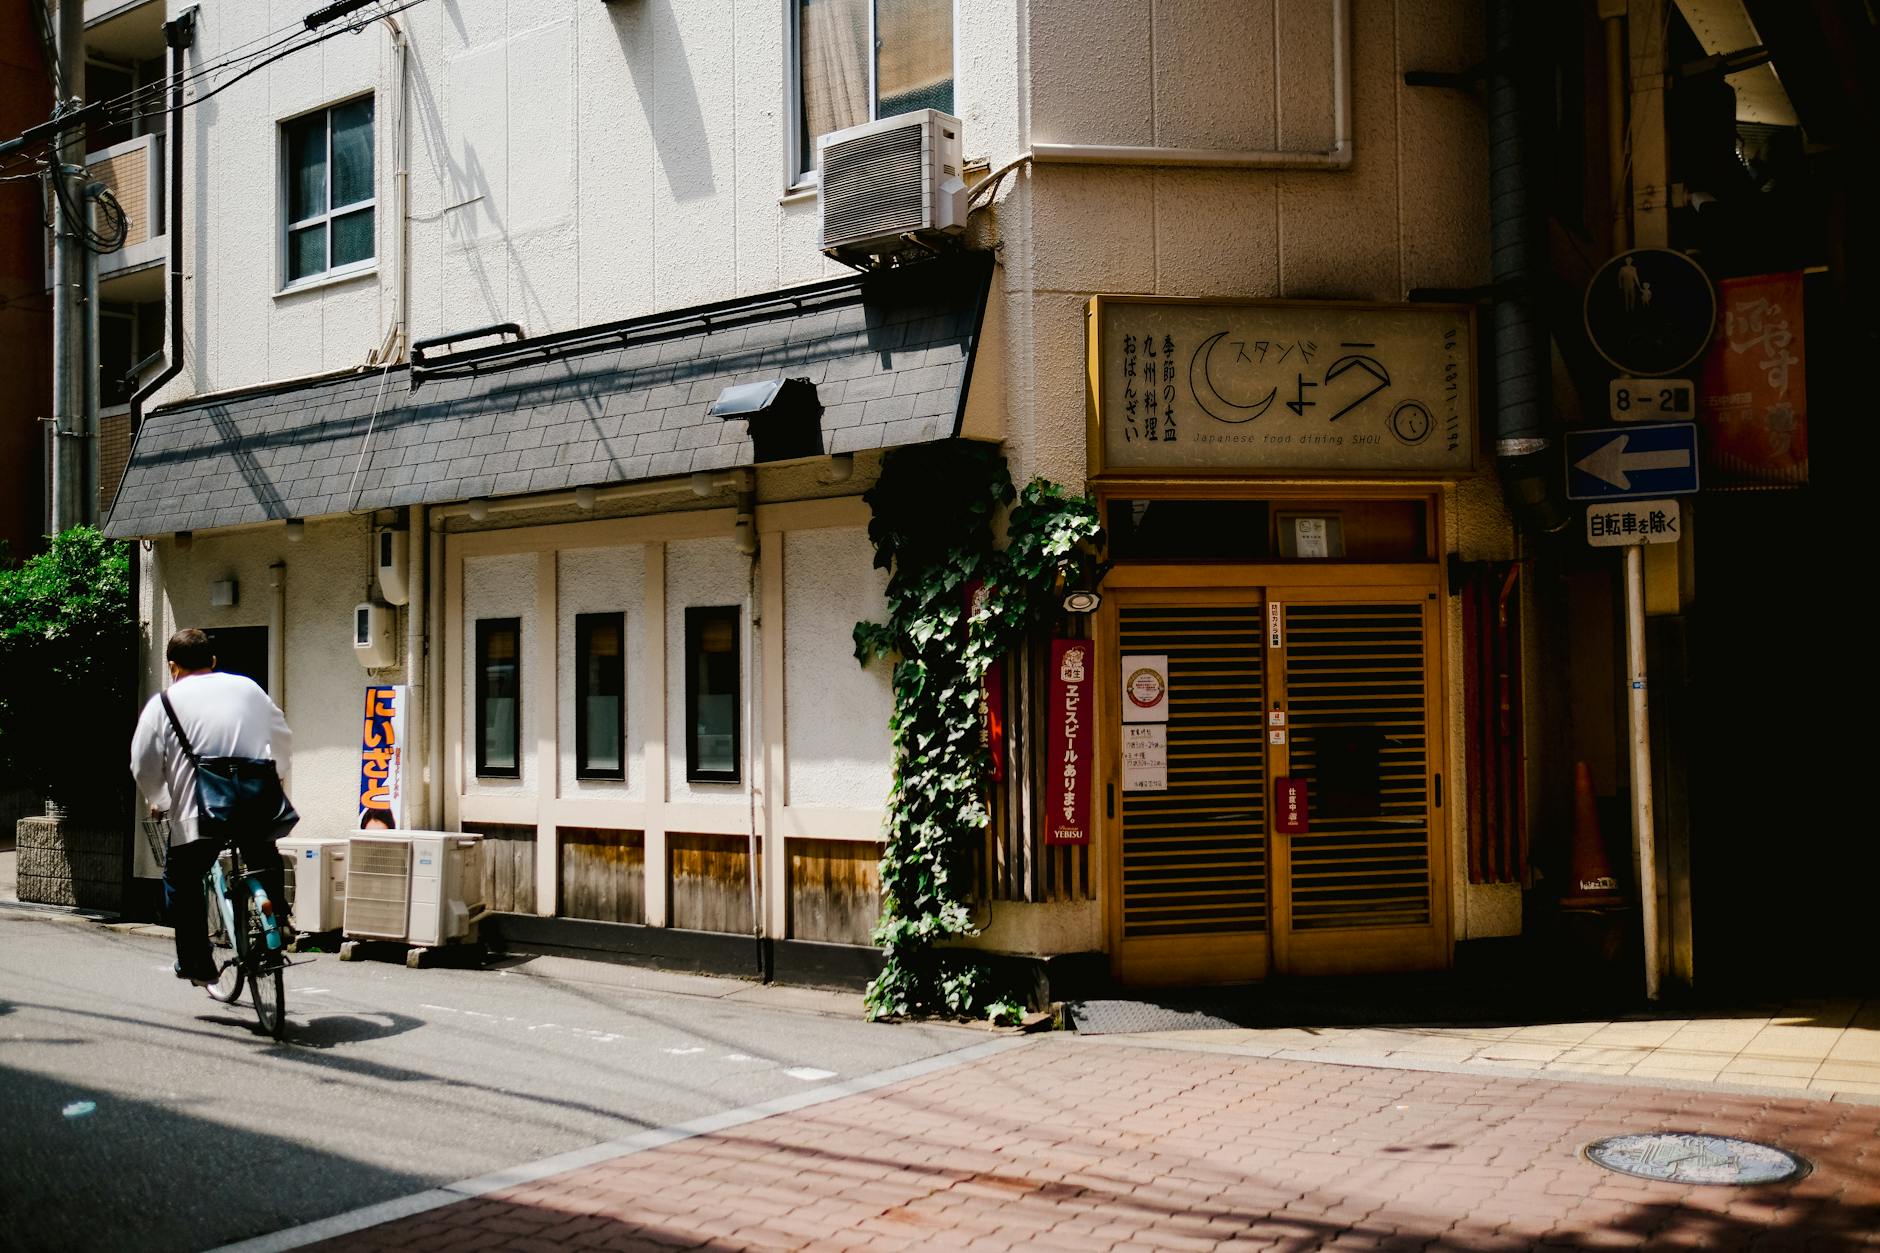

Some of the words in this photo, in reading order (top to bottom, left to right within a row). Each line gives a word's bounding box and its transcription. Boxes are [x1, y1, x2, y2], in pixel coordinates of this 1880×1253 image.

[1230, 340, 1318, 365] スタンド
[1123, 333, 1139, 442] おばんざい
[1143, 333, 1158, 441] 九州料理
[1162, 334, 1177, 442] 季節の大皿
[1193, 432, 1255, 445] Japanese
[1263, 432, 1292, 444] food
[1299, 432, 1344, 446] dining
[1352, 433, 1382, 445] SHOU
[1591, 510, 1677, 537] 自転車を除く
[1064, 668, 1081, 679] 樽生
[1054, 829, 1083, 839] YEBISU
